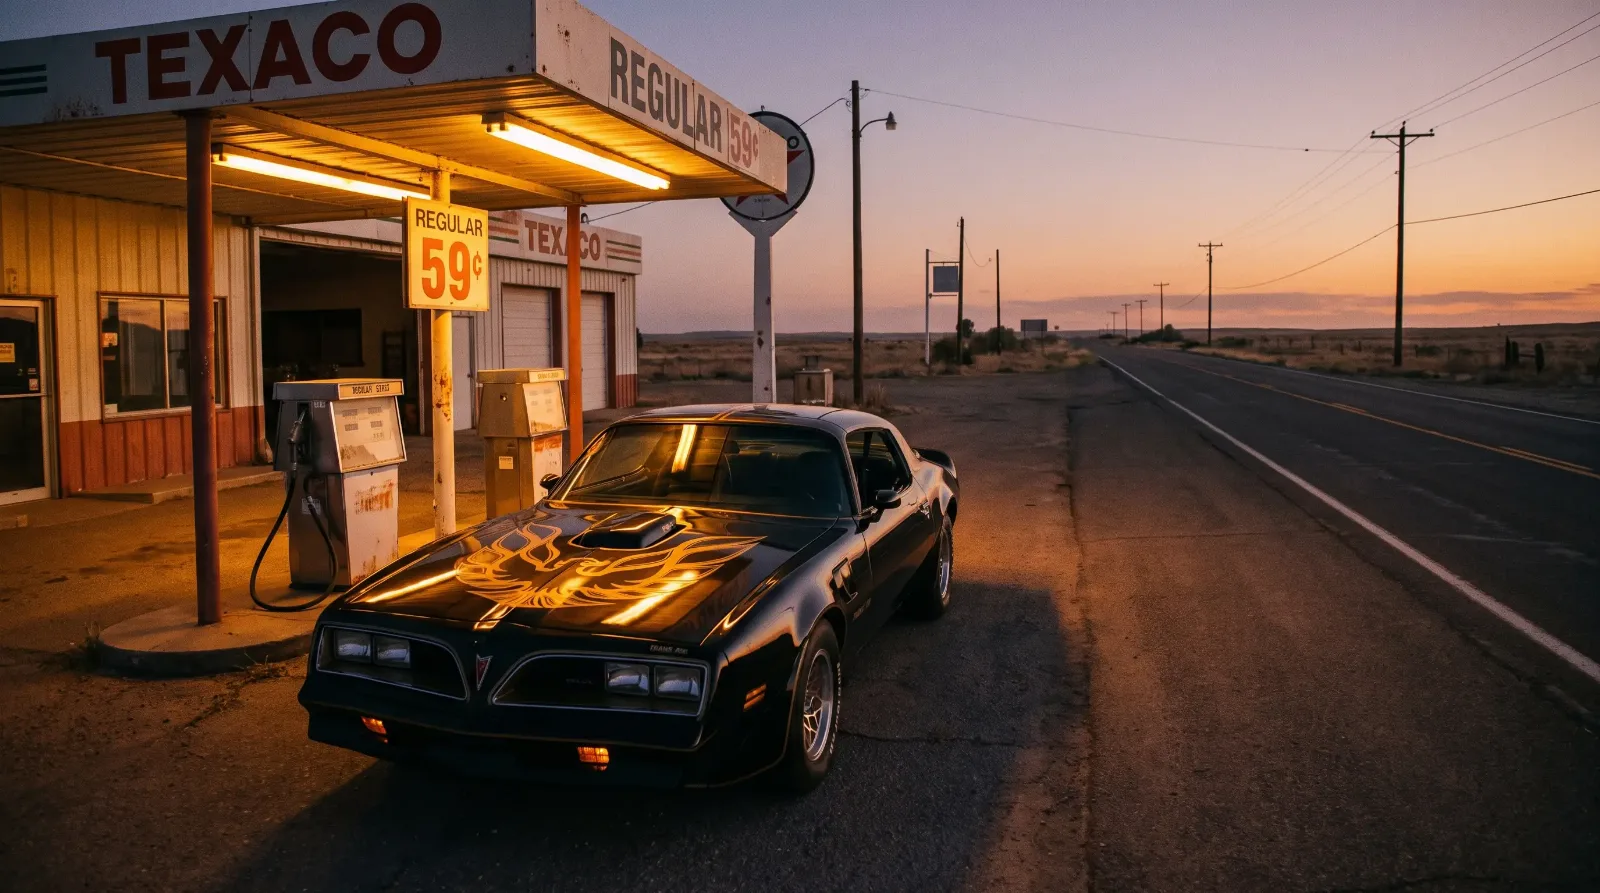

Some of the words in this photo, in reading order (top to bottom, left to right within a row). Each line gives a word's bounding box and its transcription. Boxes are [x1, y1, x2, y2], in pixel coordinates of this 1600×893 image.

[95, 3, 442, 104] TEXACO
[610, 36, 722, 153] REGULAR
[729, 115, 759, 169] 59¢
[415, 208, 483, 237] REGULAR
[524, 219, 601, 261] TEXCO
[421, 236, 482, 301] 59¢
